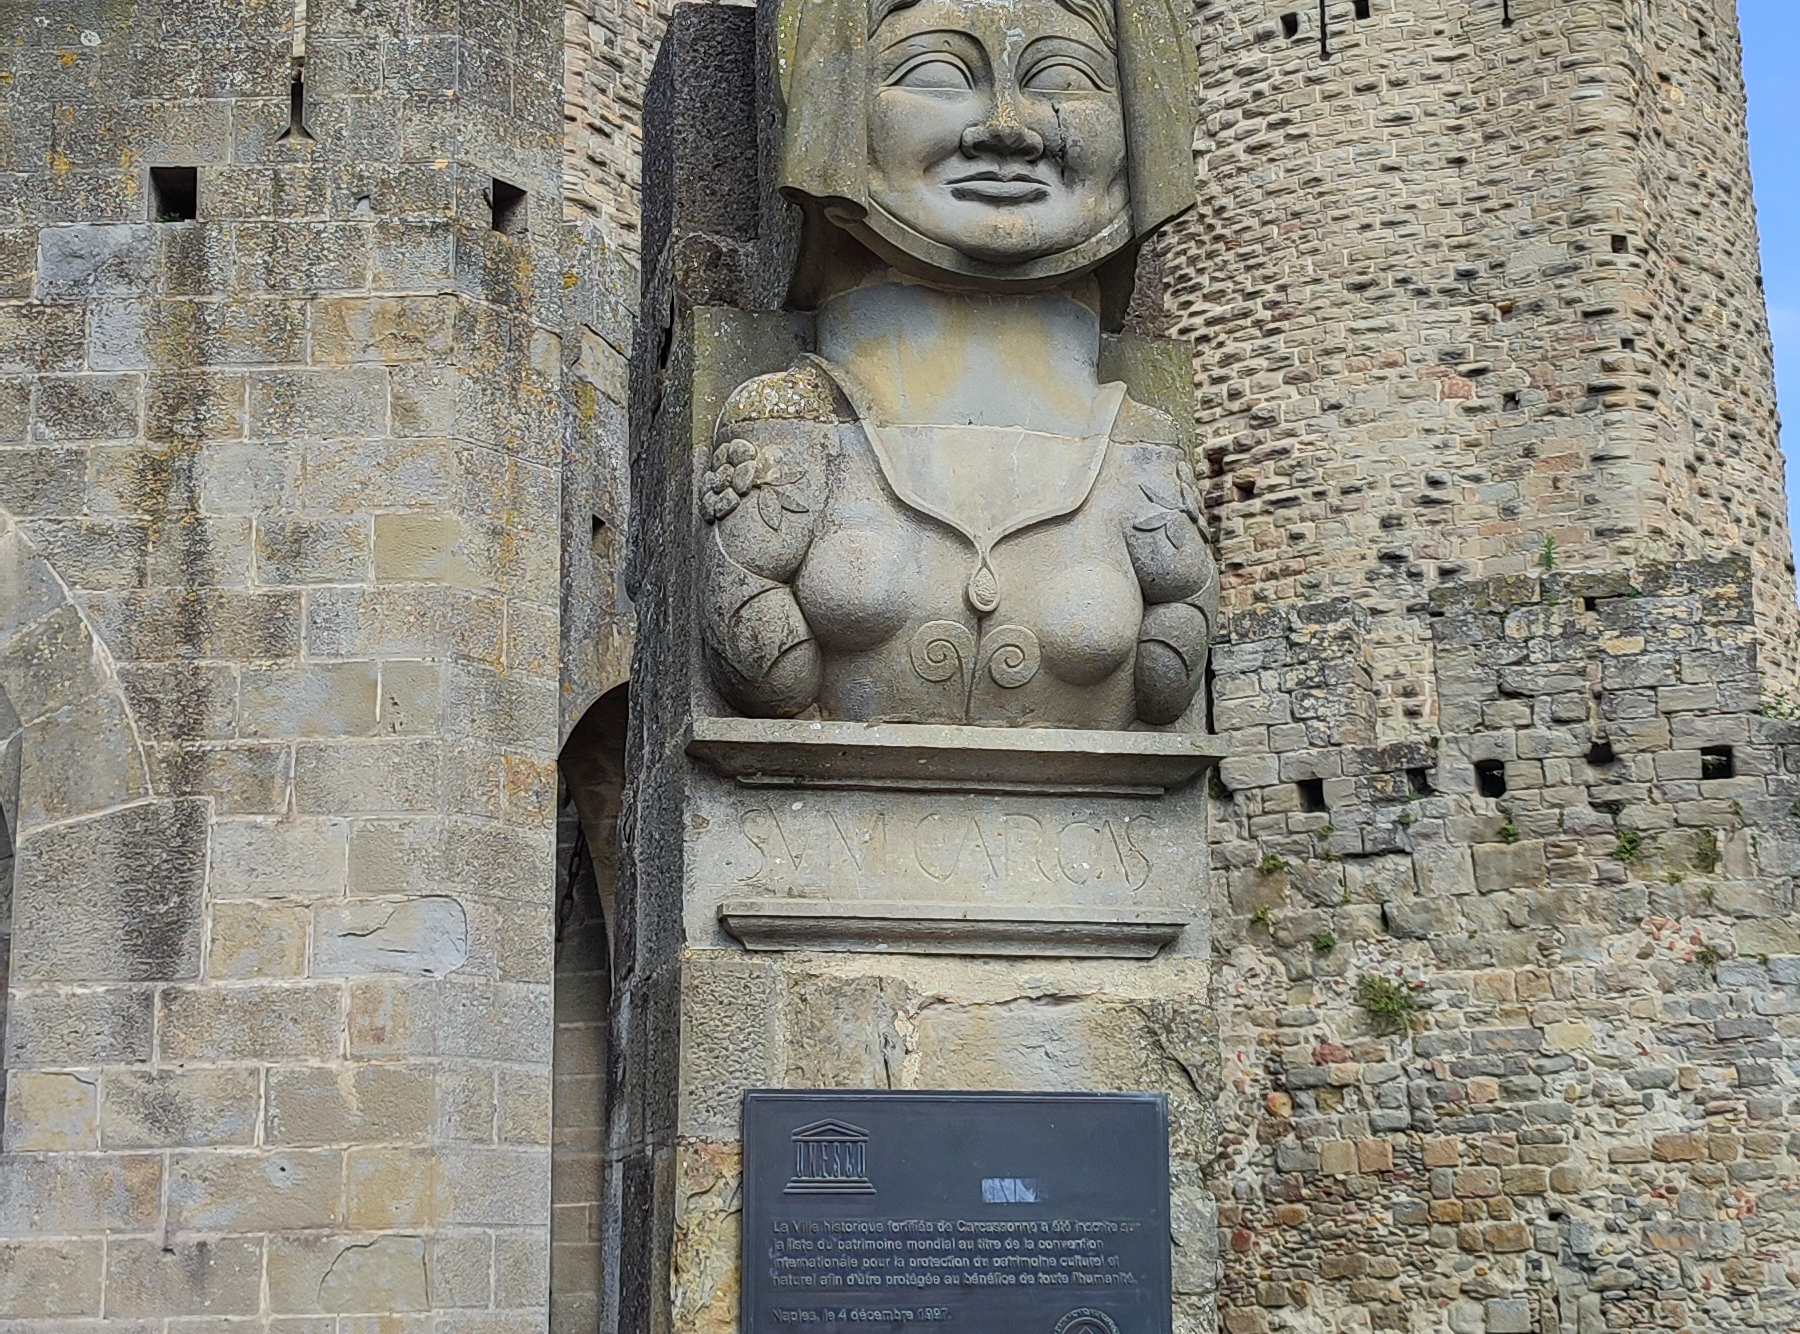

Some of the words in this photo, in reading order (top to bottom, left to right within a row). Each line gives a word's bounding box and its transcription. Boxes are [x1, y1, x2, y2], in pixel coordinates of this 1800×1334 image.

[913, 812, 1156, 893] CARCAS
[796, 1141, 866, 1178] UNESCO
[774, 1220, 788, 1233] La
[792, 1220, 819, 1233] Ville
[823, 1220, 884, 1235] historique
[937, 1220, 953, 1233] de
[956, 1220, 1038, 1233] Carcassonne
[1040, 1220, 1049, 1233] a
[1052, 1220, 1071, 1233] été
[1076, 1220, 1118, 1233] inscrite
[774, 1238, 784, 1250] la
[787, 1238, 814, 1250] liste
[817, 1238, 833, 1250] du
[837, 1238, 903, 1252] patrimoine
[907, 1238, 955, 1250] mondial
[958, 1238, 974, 1250] au
[977, 1238, 1002, 1250] titre
[1005, 1238, 1020, 1250] de
[1024, 1238, 1035, 1250] la
[1038, 1238, 1104, 1250] convention
[773, 1255, 858, 1268] internationale
[862, 1255, 890, 1270] pour
[894, 1255, 905, 1268] la
[909, 1255, 970, 1270] protection
[973, 1255, 989, 1268] du
[992, 1255, 1057, 1270] patrimoine
[1060, 1255, 1105, 1268] culturel
[1107, 1255, 1120, 1268] et
[772, 1273, 815, 1286] naturel
[820, 1273, 843, 1286] afin
[846, 1273, 882, 1286] d'être
[886, 1273, 941, 1288] protégée
[944, 1273, 960, 1286] au
[963, 1273, 1016, 1286] bénéfice
[1019, 1273, 1035, 1286] de
[1038, 1273, 1069, 1286] toute
[823, 1308, 835, 1321] le
[838, 1308, 847, 1321] 4
[850, 1308, 914, 1321] décembre
